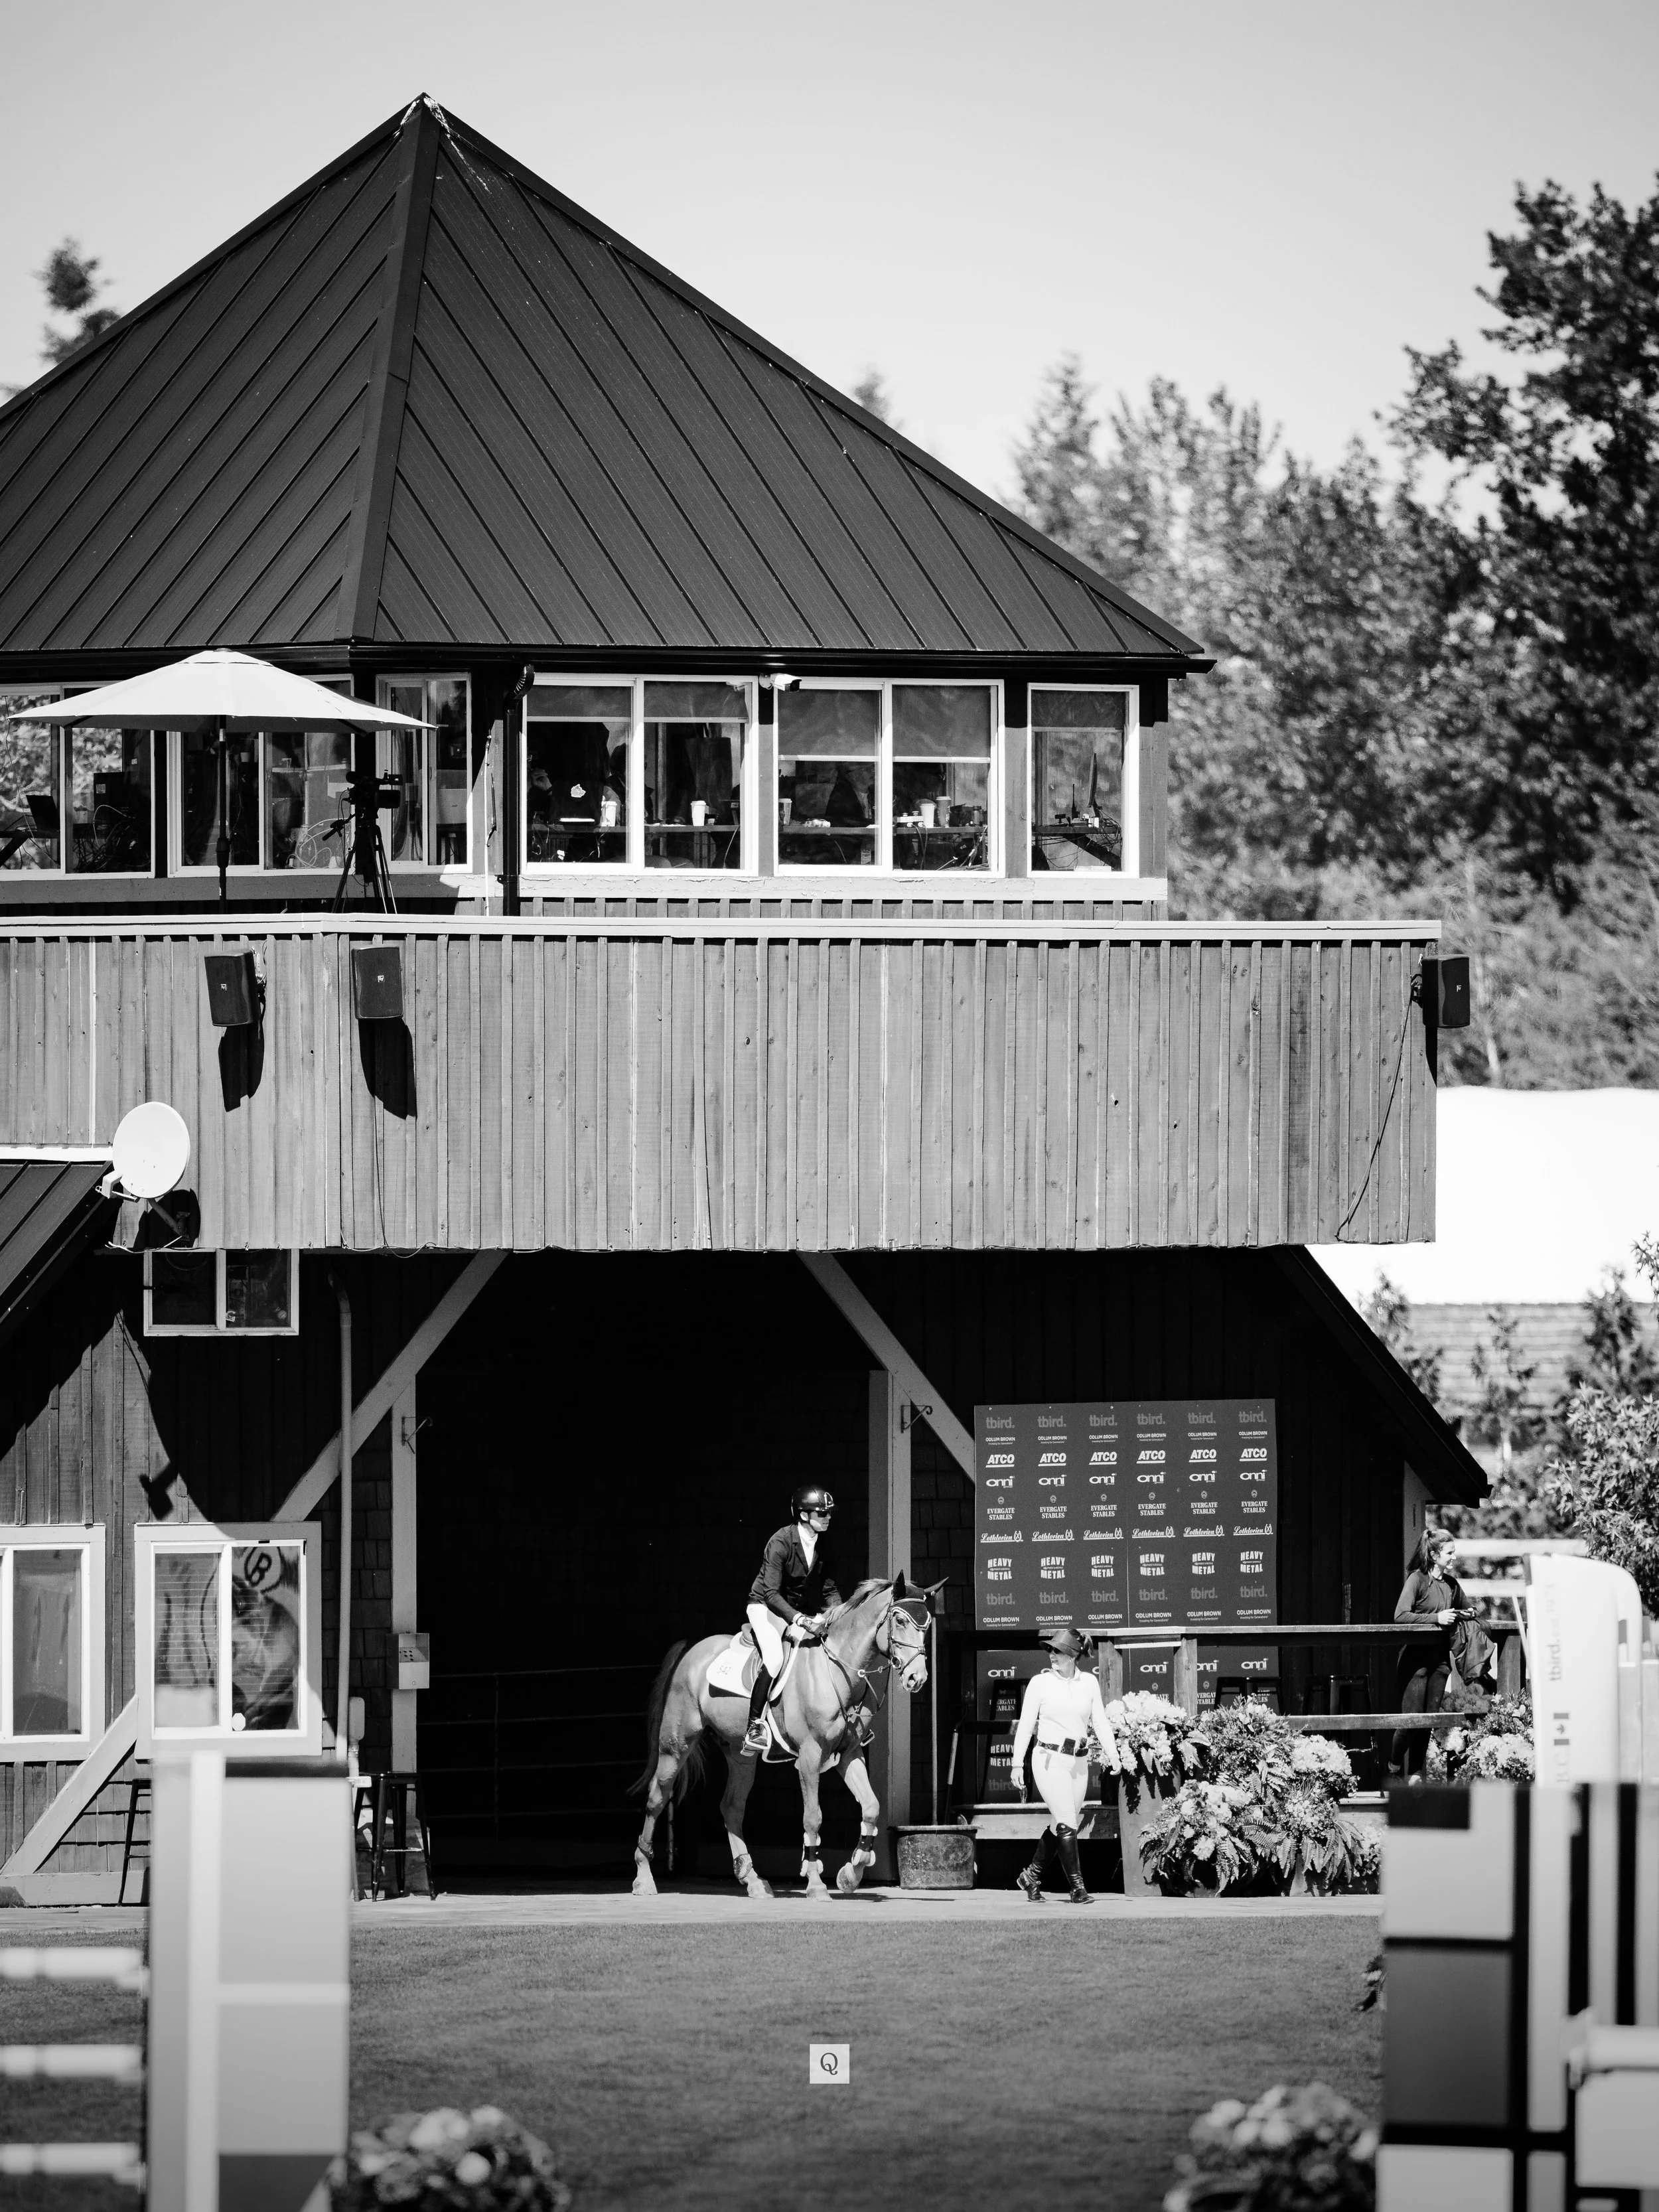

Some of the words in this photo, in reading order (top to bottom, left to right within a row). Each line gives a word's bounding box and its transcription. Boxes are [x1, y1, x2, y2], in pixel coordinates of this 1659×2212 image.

[1091, 1451, 1117, 1462] ATCO
[1138, 1450, 1165, 1460] ATCO
[1190, 1449, 1216, 1459] ATCO
[1241, 1448, 1267, 1457] ATCO
[987, 1454, 1015, 1465] ATCO
[1040, 1453, 1066, 1463] ATCO
[1090, 1473, 1116, 1485] onni
[1137, 1472, 1164, 1483] onni
[1189, 1471, 1216, 1483] onni
[1240, 1469, 1266, 1481] onni
[986, 1476, 1014, 1487] onni
[1039, 1475, 1066, 1486] onni
[1132, 1528, 1165, 1537] Lothlorien
[1183, 1527, 1214, 1536] Lothlorien
[1092, 1556, 1114, 1566] HEAVY
[1140, 1554, 1164, 1564] HEAVY
[1192, 1552, 1215, 1563] HEAVY
[1241, 1551, 1263, 1562] HEAVY
[988, 1558, 1011, 1569] HEAVY
[1041, 1557, 1064, 1568] HEAVY
[1092, 1567, 1114, 1577] METAL
[1140, 1566, 1165, 1576] METAL
[1192, 1564, 1214, 1574] METAL
[1240, 1563, 1263, 1573] METAL
[987, 1570, 1012, 1580] METAL
[1041, 1569, 1065, 1579] METAL
[1140, 1662, 1167, 1673] onni
[1241, 1658, 1267, 1669] onni
[988, 1666, 1015, 1678] onni
[990, 1757, 1013, 1767] META
